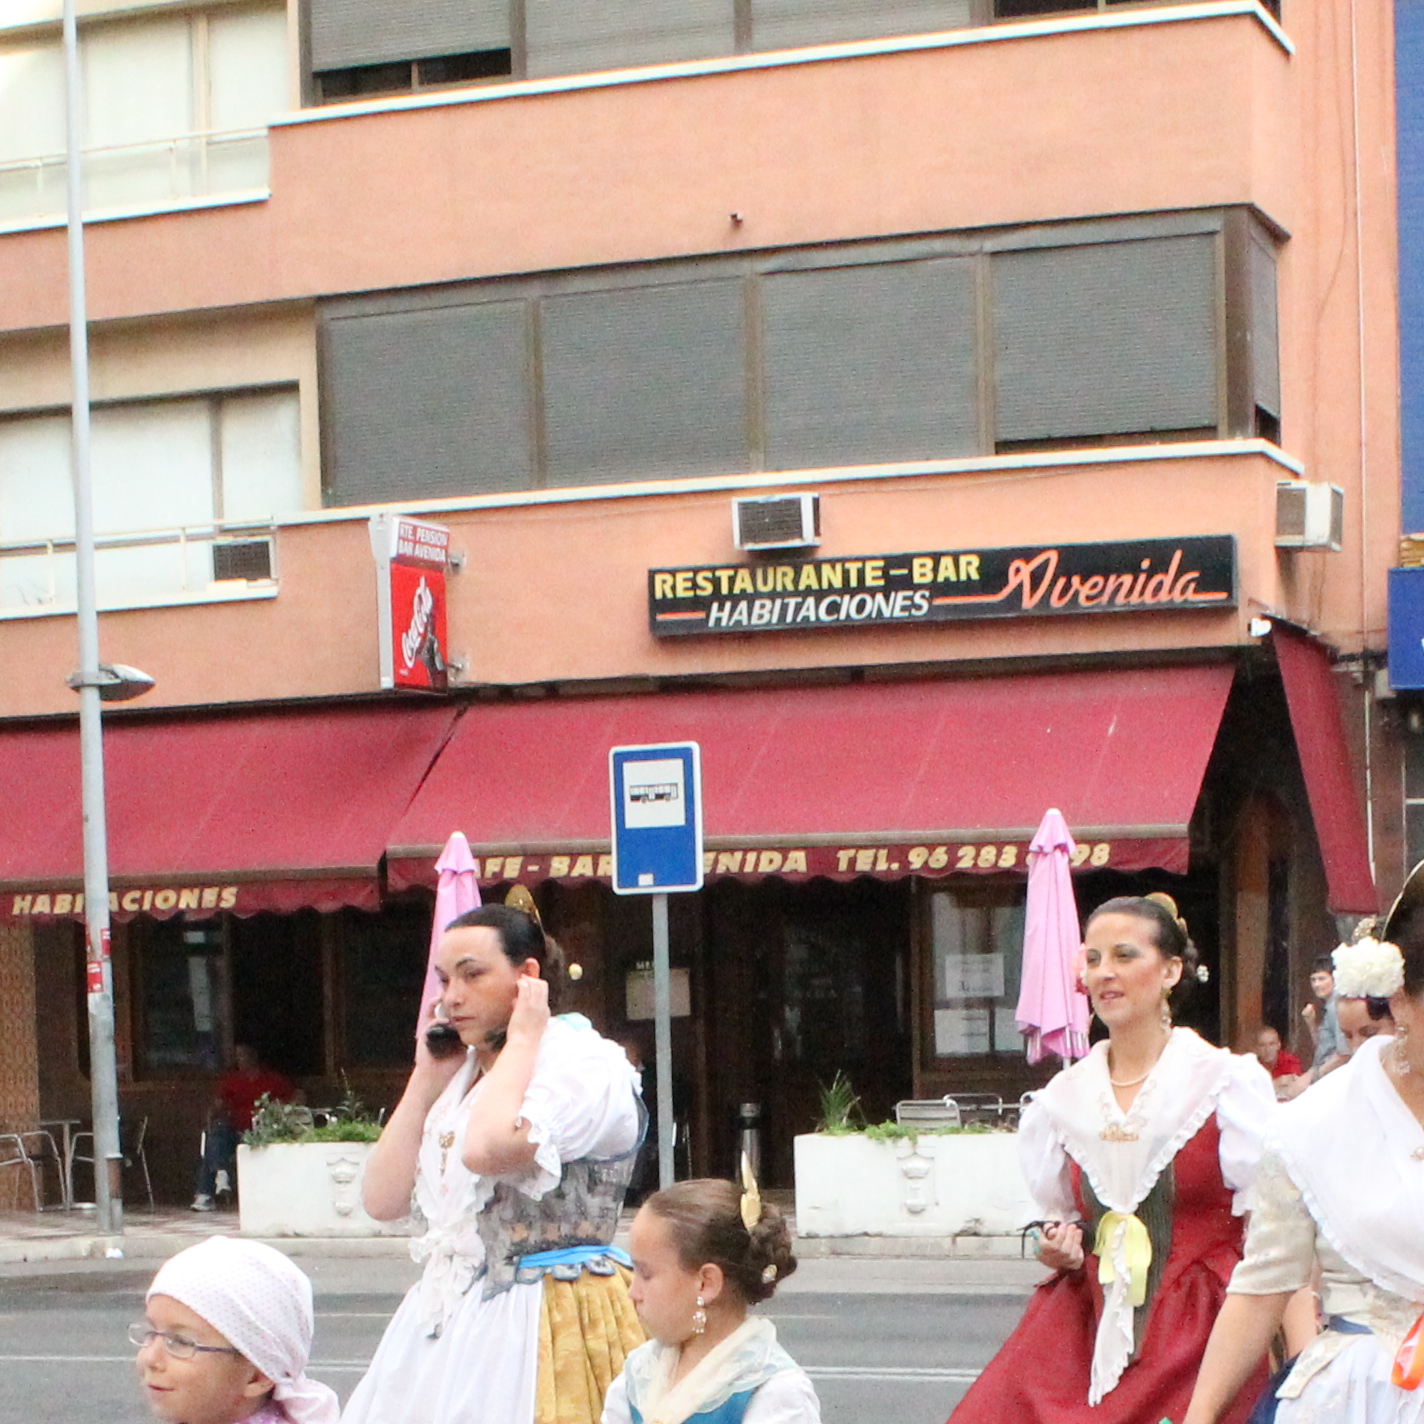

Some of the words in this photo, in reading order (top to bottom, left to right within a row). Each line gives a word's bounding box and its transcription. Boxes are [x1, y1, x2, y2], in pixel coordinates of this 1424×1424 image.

[398, 539, 414, 556] BAR
[994, 549, 1228, 610] Avenida
[708, 590, 930, 628] HABITACIONES
[704, 850, 807, 874] ENIDA
[836, 848, 900, 872] TEL.
[908, 846, 948, 870] 96
[955, 845, 1018, 868] 283
[12, 887, 238, 915] HABIACIONES
